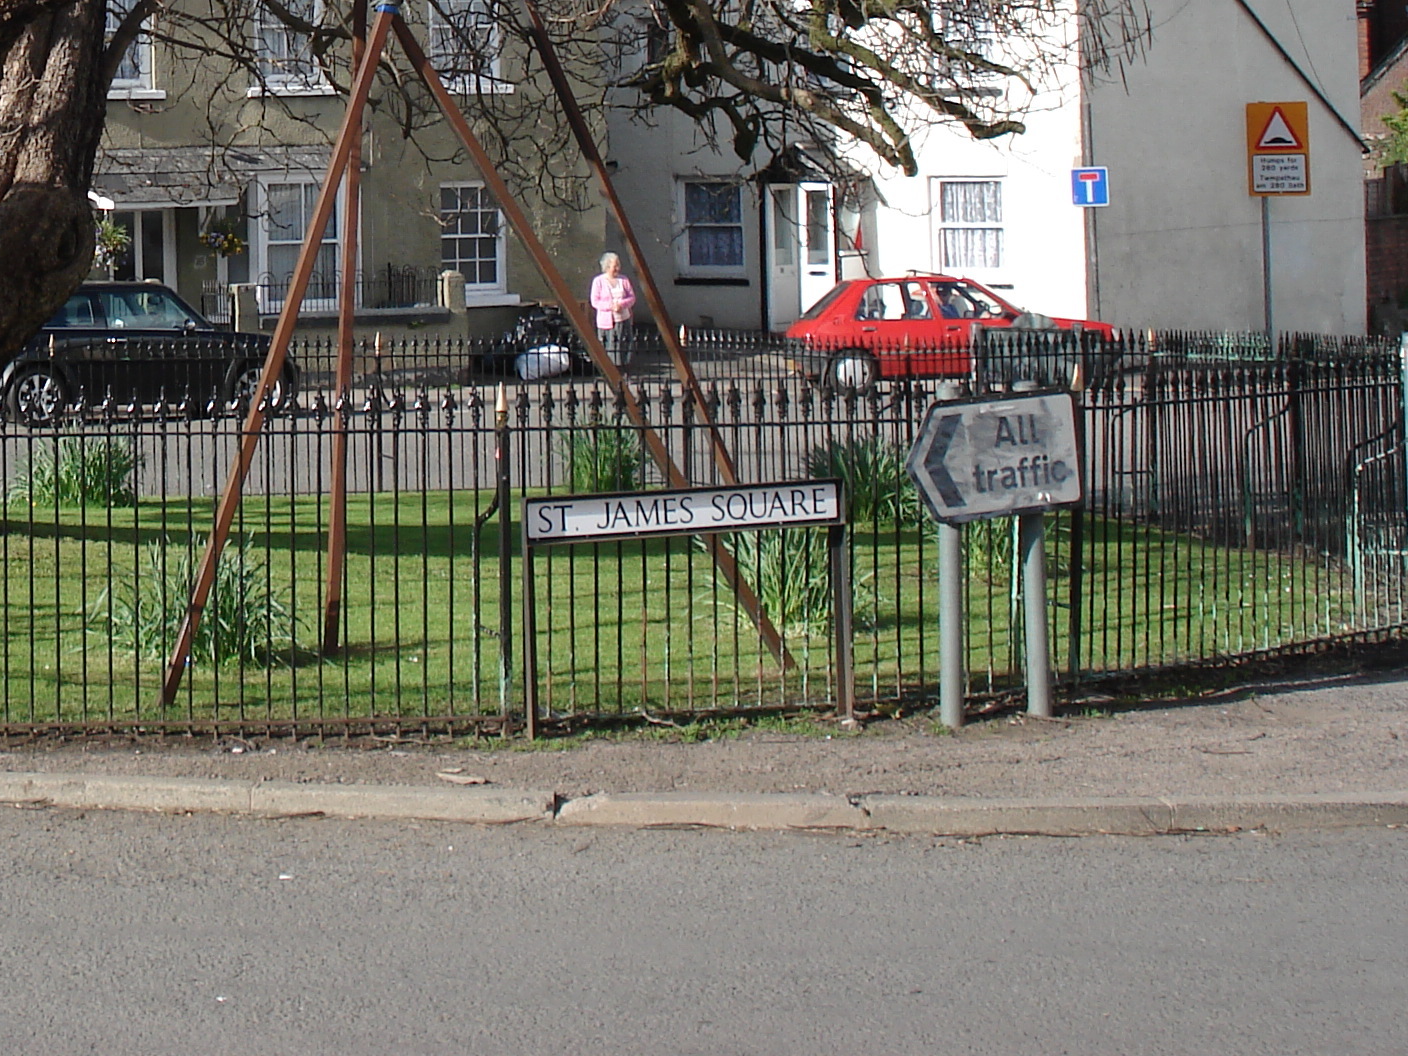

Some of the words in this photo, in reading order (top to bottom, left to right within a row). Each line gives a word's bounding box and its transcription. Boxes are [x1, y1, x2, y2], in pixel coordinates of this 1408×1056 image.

[994, 414, 1040, 448] All
[972, 454, 1069, 493] traffic
[538, 504, 579, 534] ST.
[597, 496, 694, 530] JAMES
[711, 488, 827, 522] SQUARE
